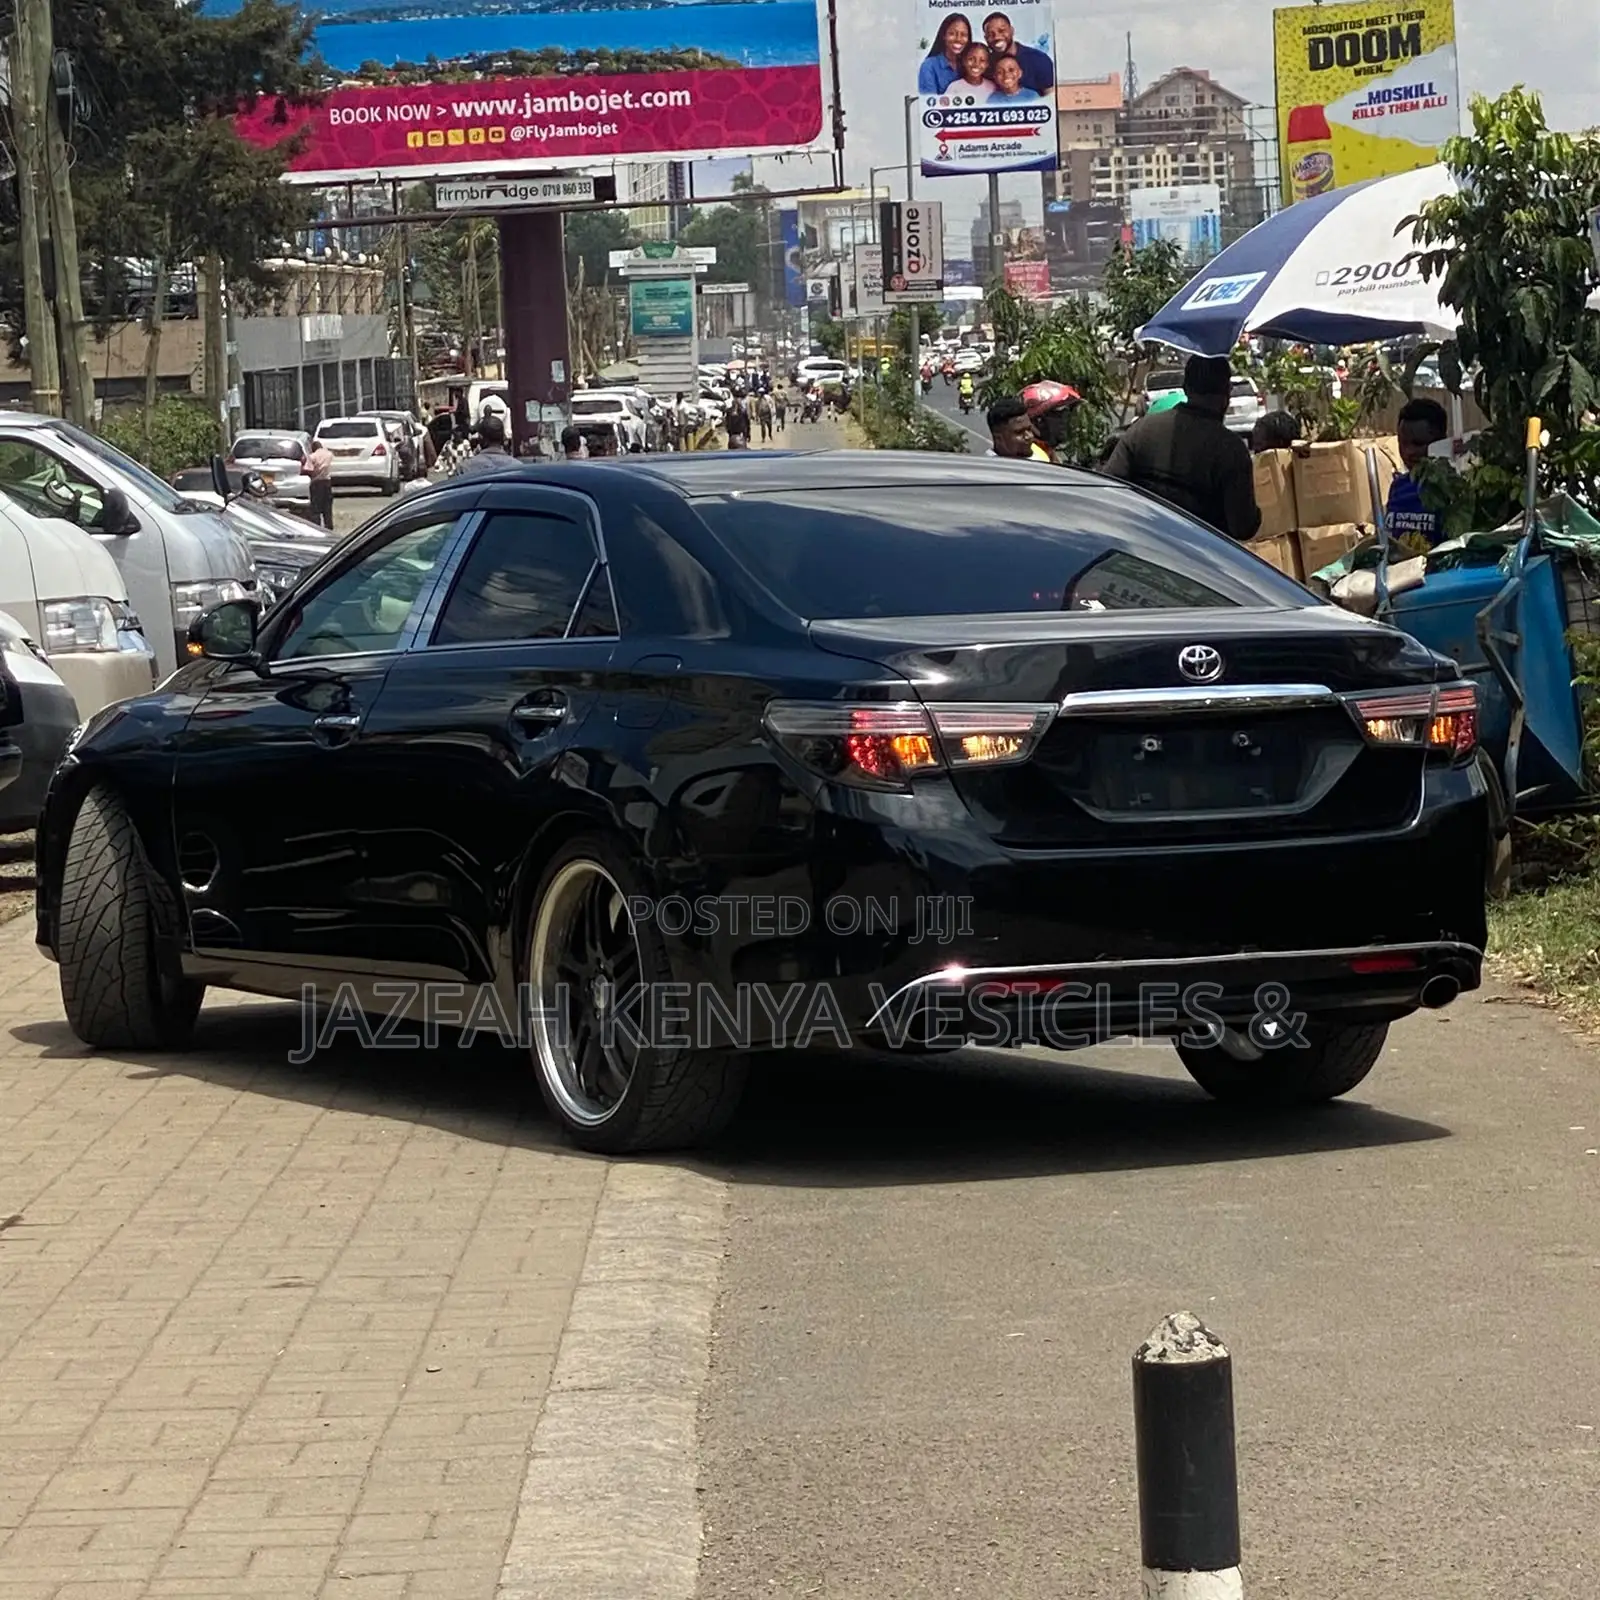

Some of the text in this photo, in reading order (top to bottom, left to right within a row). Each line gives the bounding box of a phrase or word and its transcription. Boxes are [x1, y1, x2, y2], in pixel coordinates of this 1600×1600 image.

[1303, 10, 1425, 35] MOSQUITOS MEET THEIR
[1308, 23, 1422, 72] DOOM
[330, 106, 382, 125] BOOK
[386, 104, 431, 121] NOW
[453, 88, 691, 119] www.jambojet.com
[946, 109, 1050, 124] +254 721 693 025
[1352, 105, 1385, 120] KILLS
[1389, 100, 1420, 115] THEM
[510, 121, 618, 143] @FlyJambojet
[958, 141, 1022, 153] Adams Arcade
[542, 184, 561, 196] 0718
[578, 182, 592, 194] 333
[906, 207, 921, 274] azone
[1192, 278, 1258, 303] 1XBET
[1337, 279, 1421, 297] paybill number
[1395, 520, 1435, 531] ATHLETE
[1396, 512, 1436, 523] INFINITE
